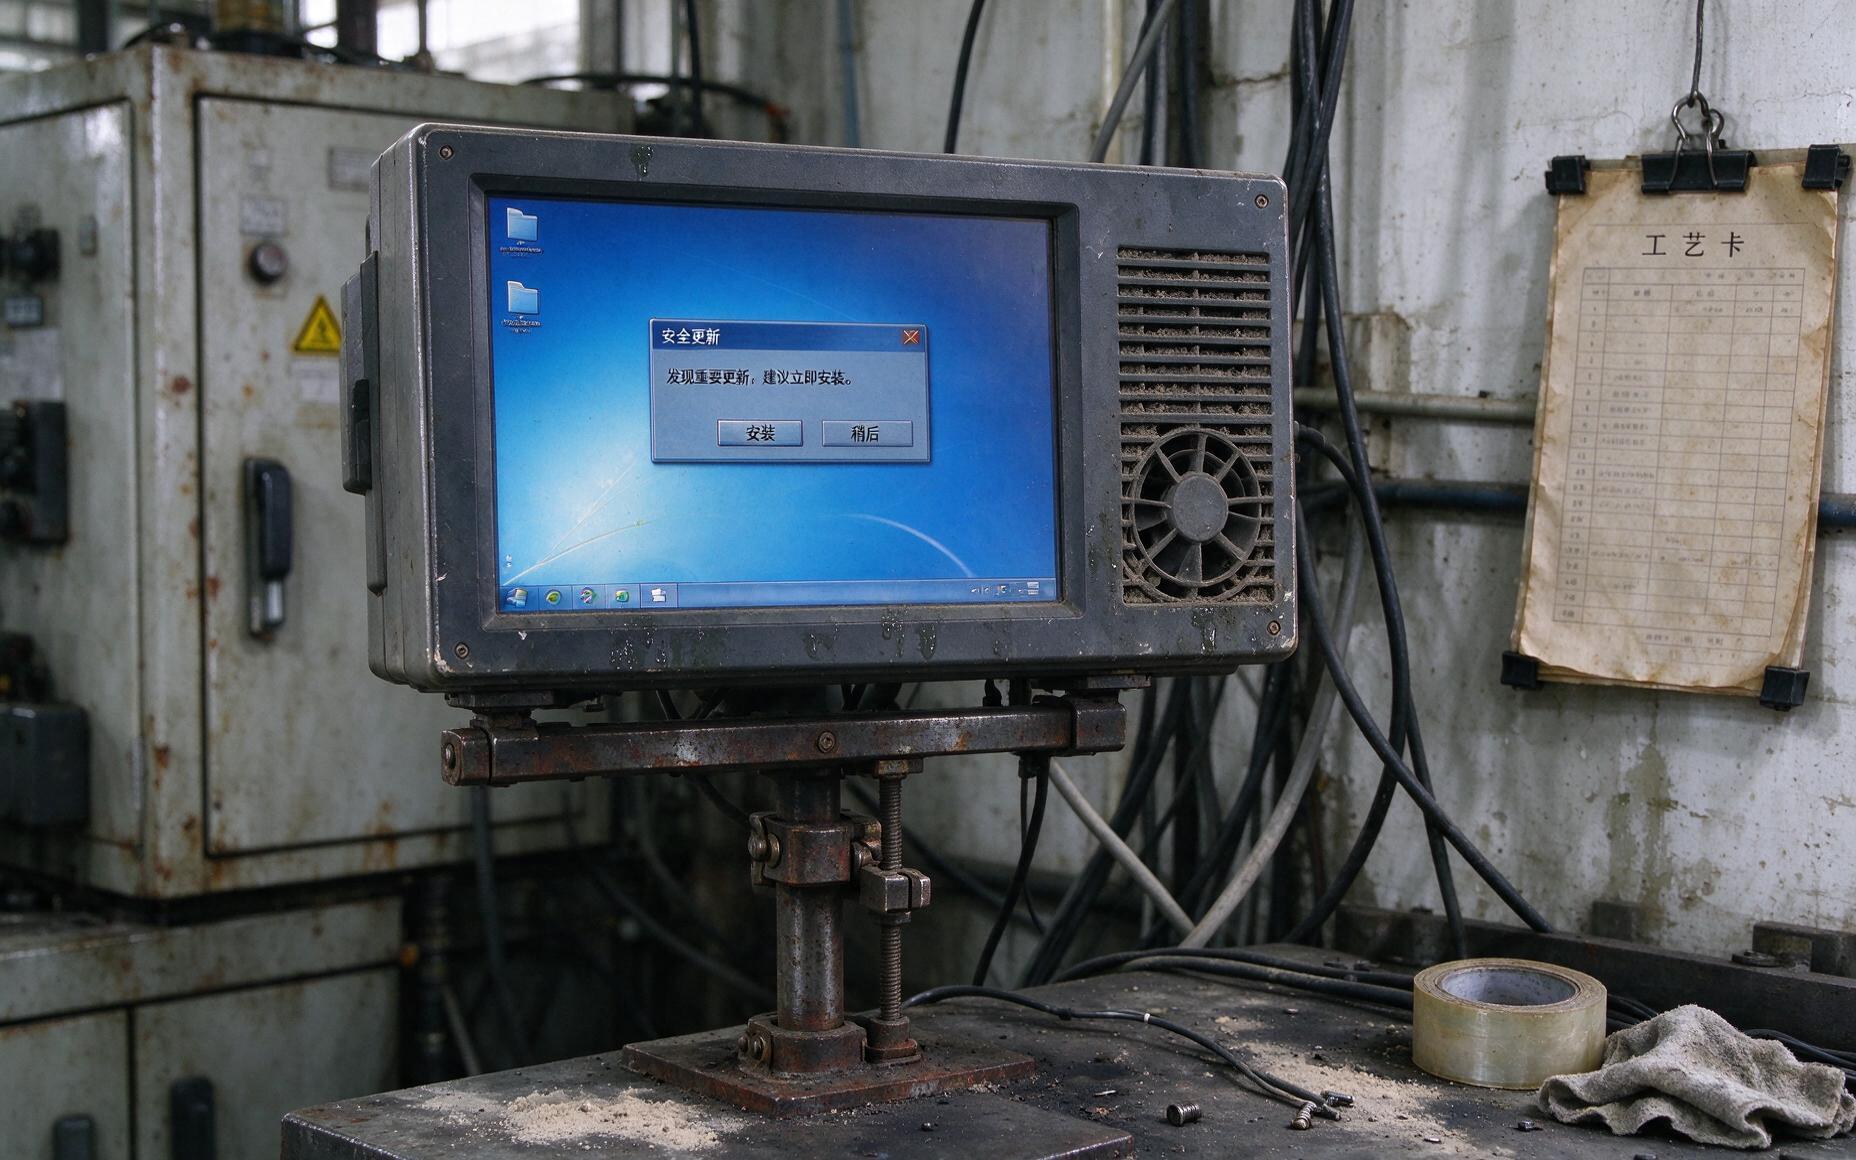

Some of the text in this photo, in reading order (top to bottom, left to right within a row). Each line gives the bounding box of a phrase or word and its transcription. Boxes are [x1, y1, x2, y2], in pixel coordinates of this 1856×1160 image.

[1642, 231, 1745, 258] 工艺卡
[661, 328, 721, 346] 安全更新
[746, 424, 776, 442] 安装
[851, 425, 879, 443] 稍后
